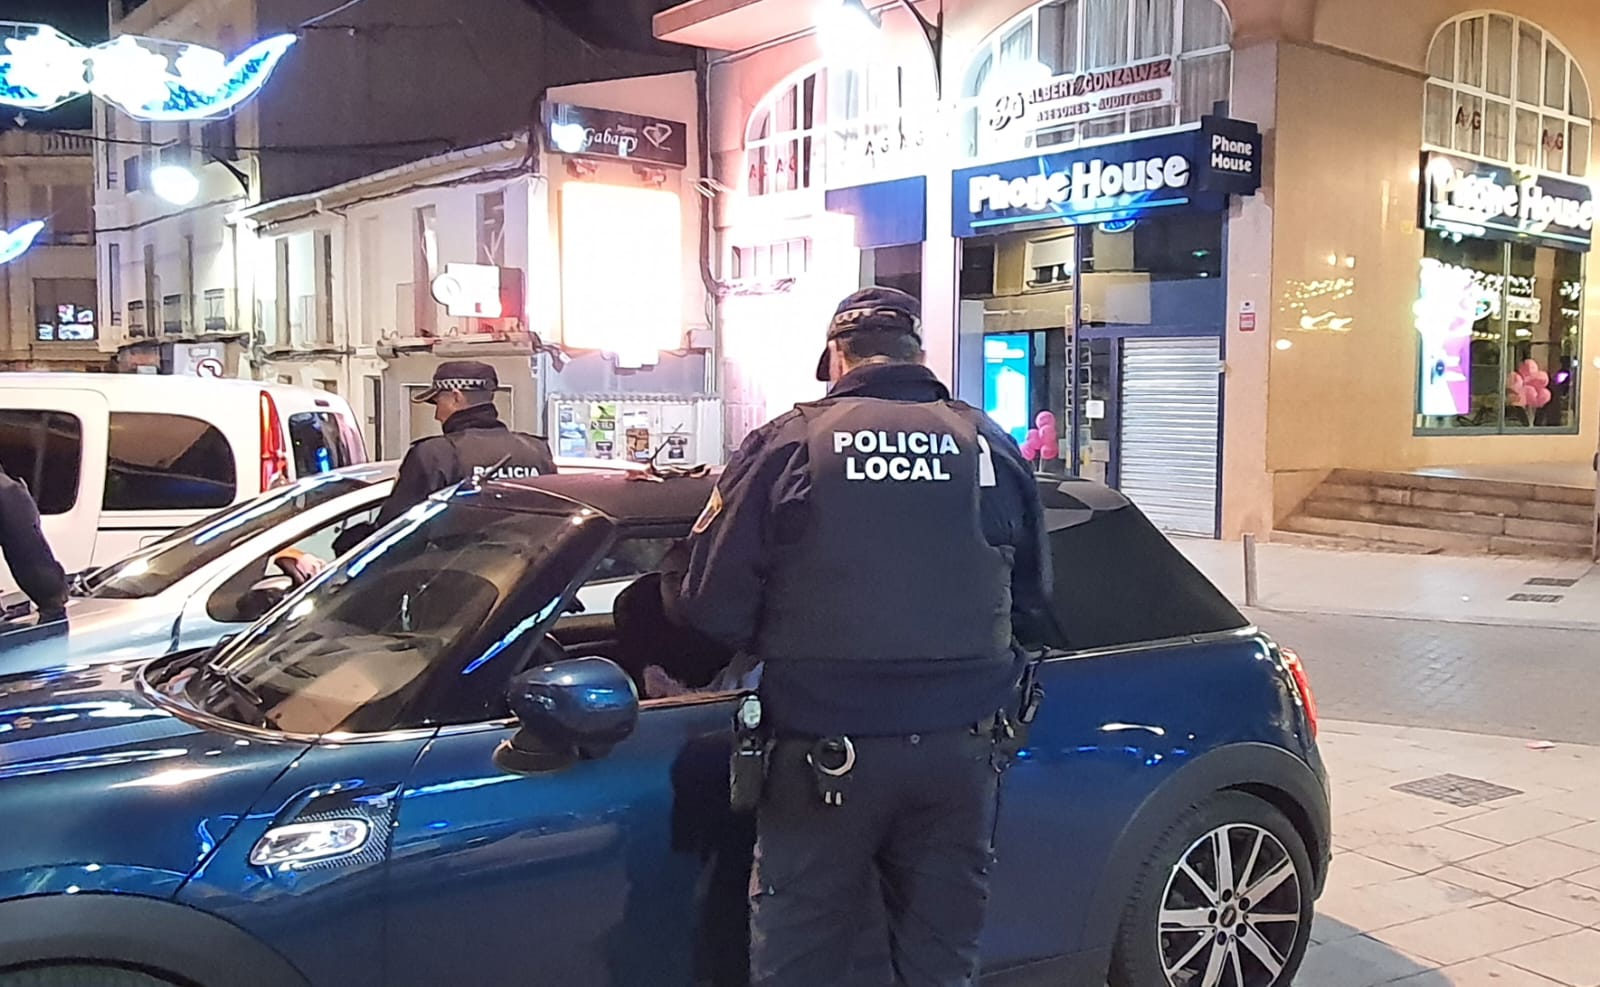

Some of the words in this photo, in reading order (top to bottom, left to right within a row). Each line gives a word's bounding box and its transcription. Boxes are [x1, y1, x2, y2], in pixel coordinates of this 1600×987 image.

[1211, 134, 1253, 156] Phone
[1211, 152, 1253, 173] House
[969, 171, 1072, 213] Phone
[1070, 155, 1190, 202] House
[833, 430, 960, 455] POLICIA
[846, 456, 950, 481] LOCAL
